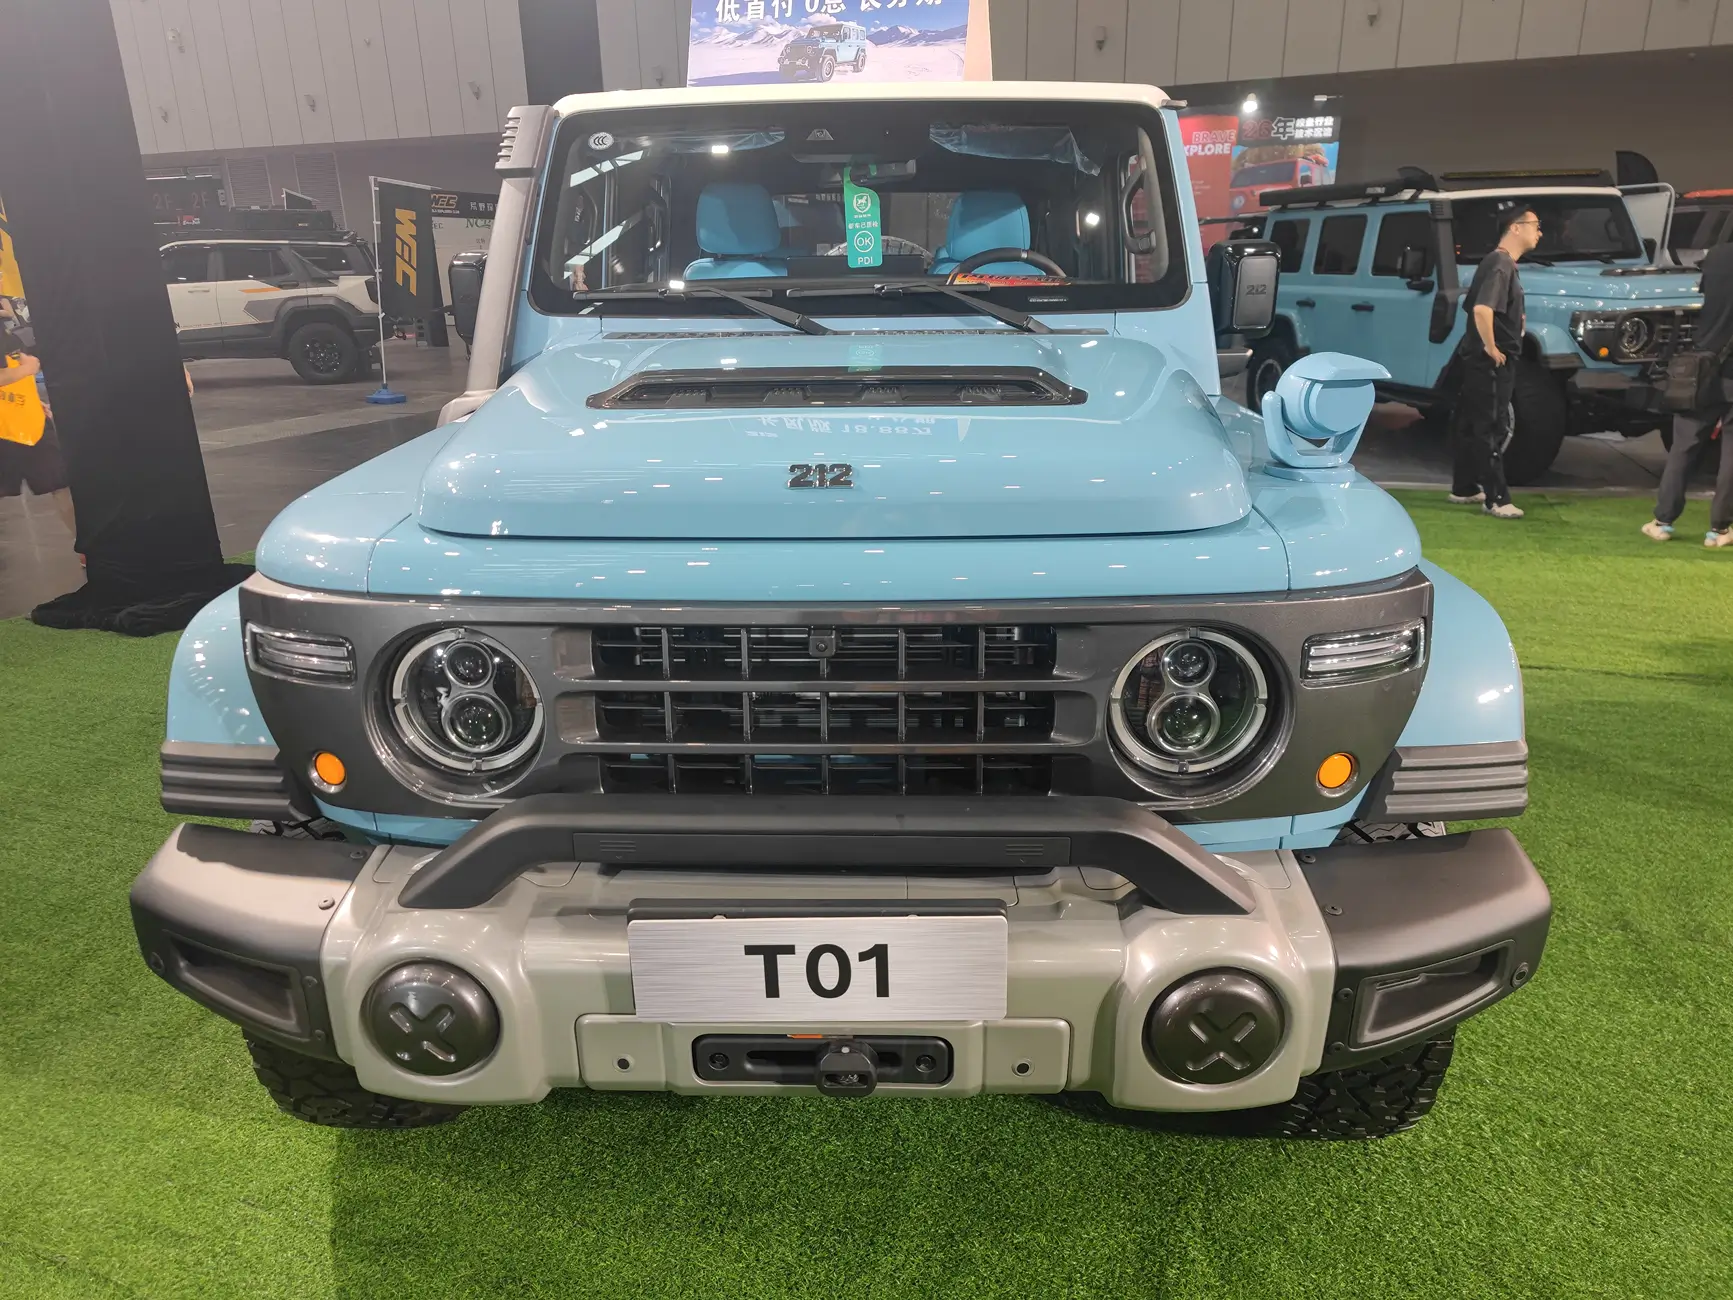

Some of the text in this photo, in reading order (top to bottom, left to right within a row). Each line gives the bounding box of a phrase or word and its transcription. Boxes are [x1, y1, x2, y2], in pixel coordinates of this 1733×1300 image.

[715, 0, 792, 23] 低首付
[1192, 129, 1237, 144] BRAVE
[1183, 142, 1232, 156] XPLORE
[856, 237, 872, 247] OK
[395, 208, 417, 297] WEC
[857, 256, 873, 265] PDI
[1245, 284, 1267, 296] 212
[786, 462, 854, 489] 212
[743, 943, 890, 999] T01
